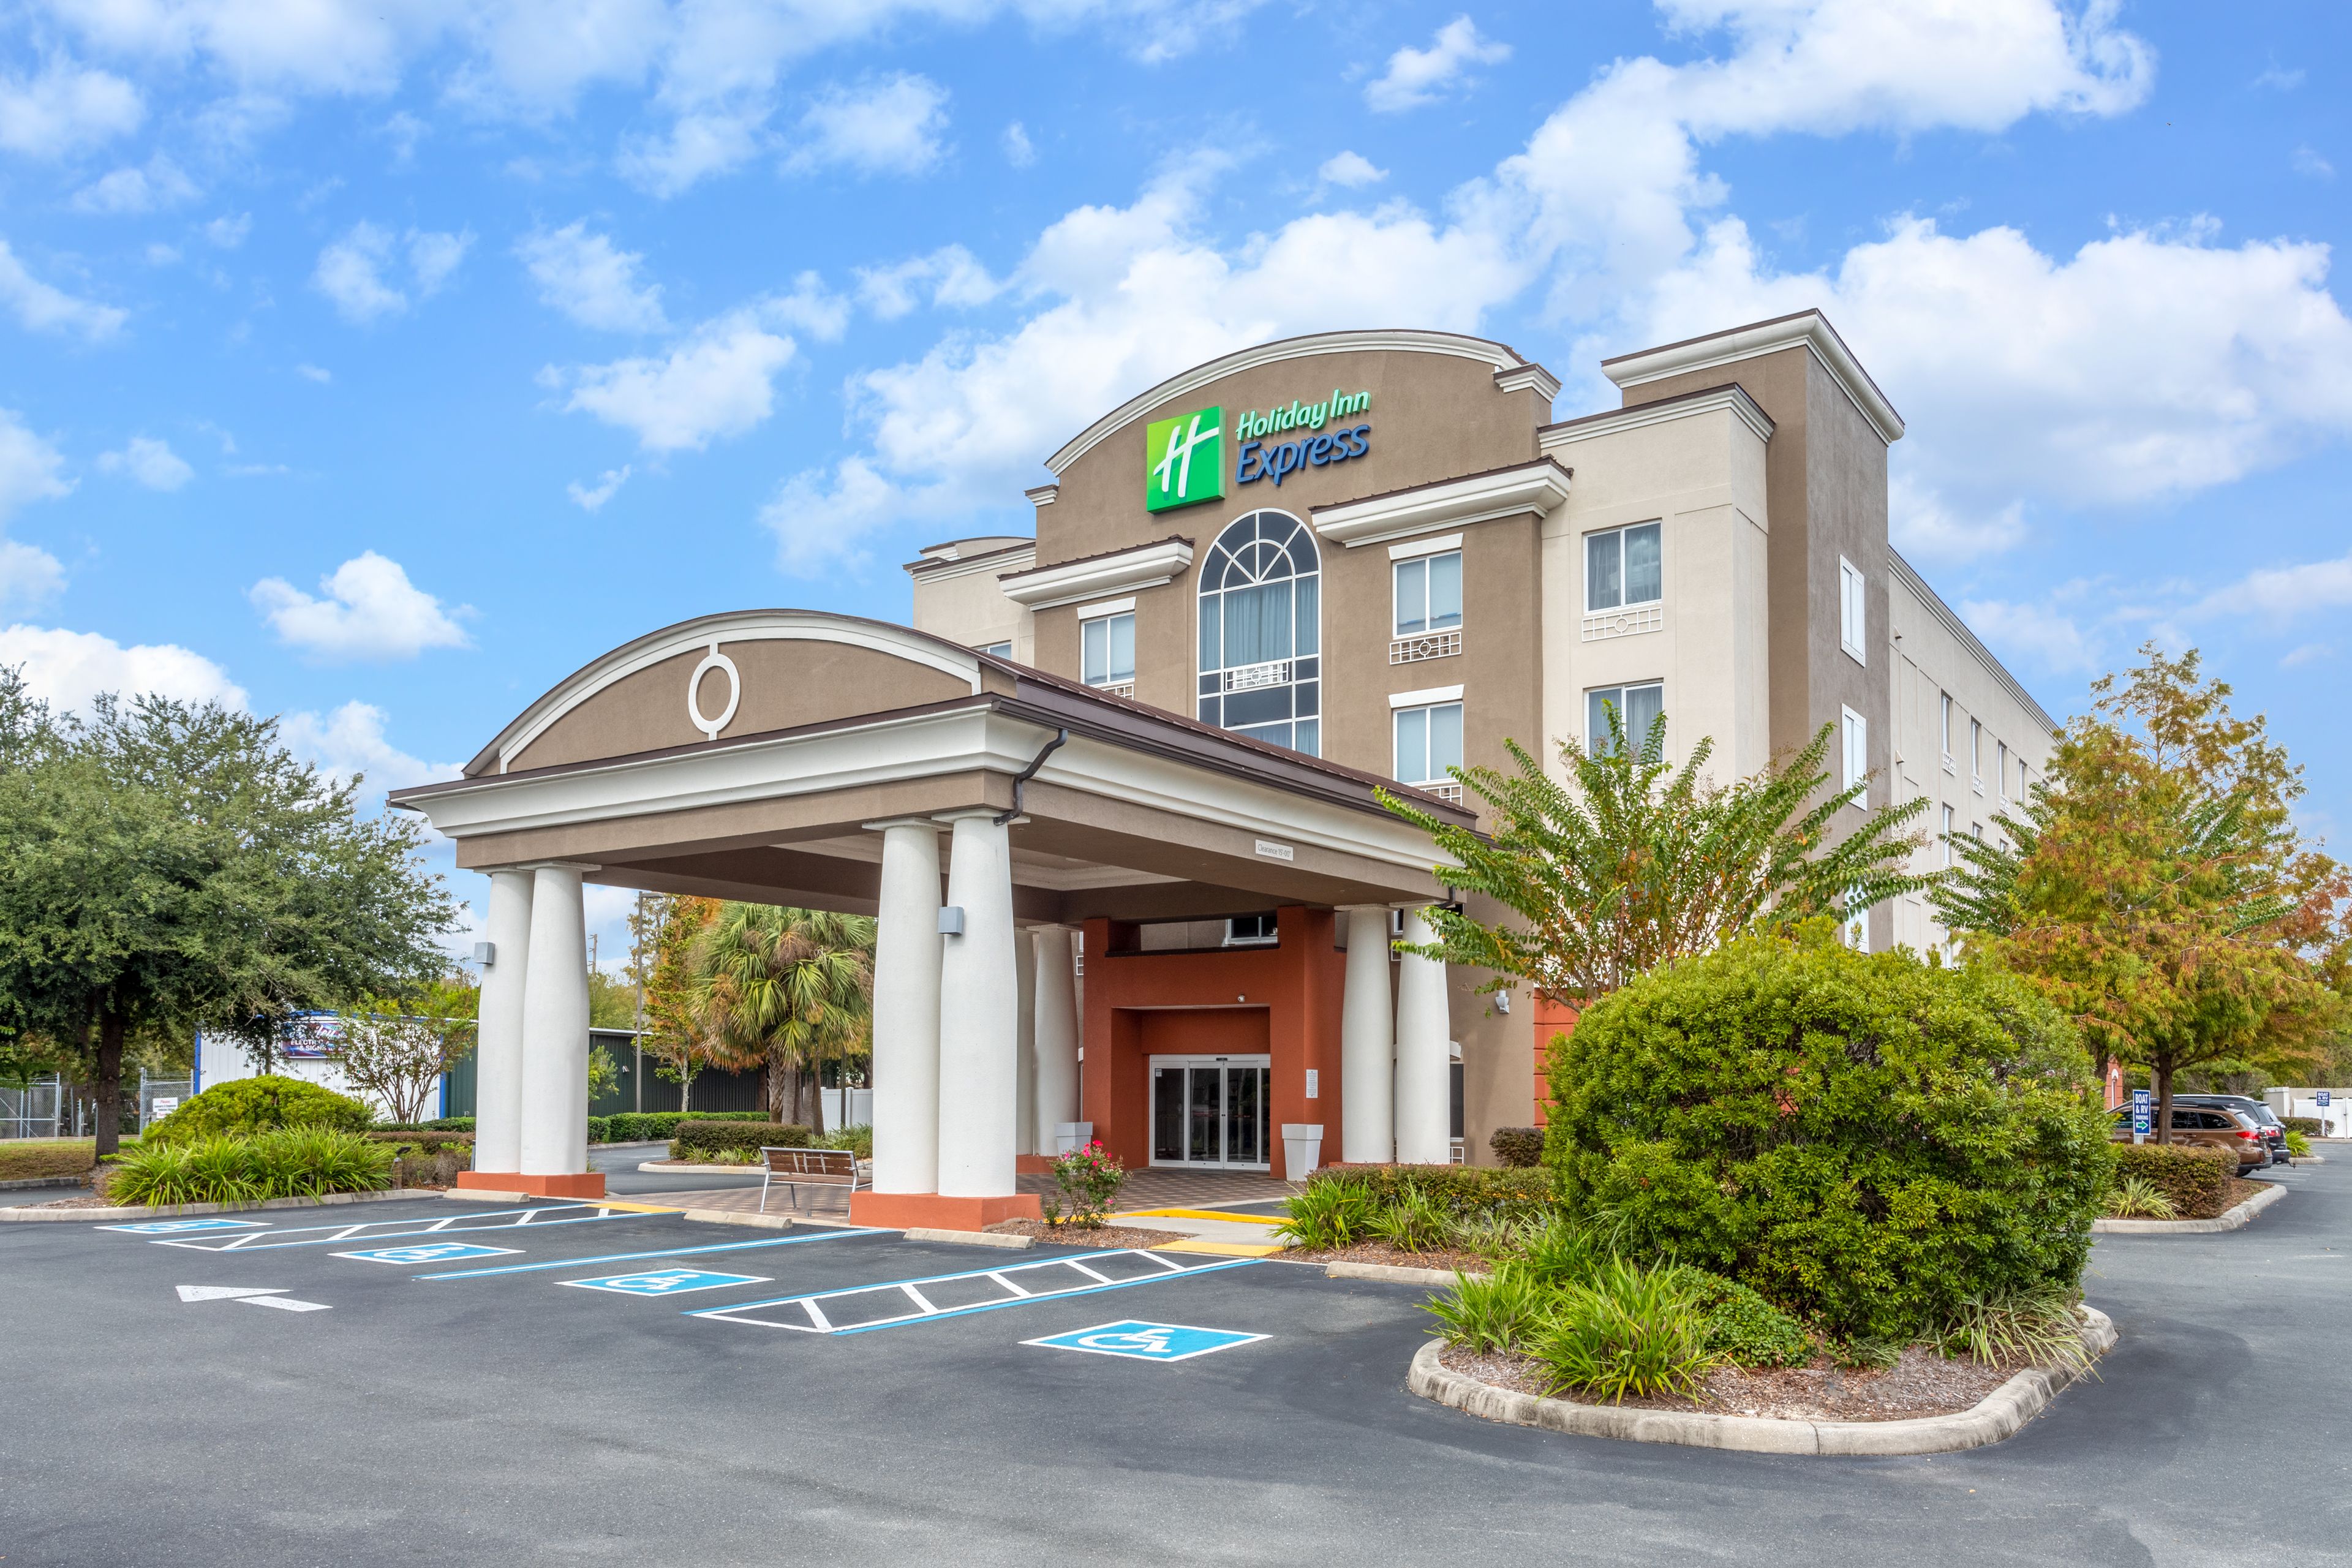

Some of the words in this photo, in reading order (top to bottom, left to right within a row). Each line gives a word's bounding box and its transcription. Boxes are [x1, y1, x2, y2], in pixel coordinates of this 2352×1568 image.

[1235, 399, 1329, 442] Holiday
[1330, 388, 1371, 419] Inn
[1235, 424, 1371, 486] Express
[1258, 843, 1278, 855] Clearance
[2135, 1093, 2148, 1104] BOAT
[2136, 1105, 2139, 1114] &
[2141, 1105, 2148, 1114] RV
